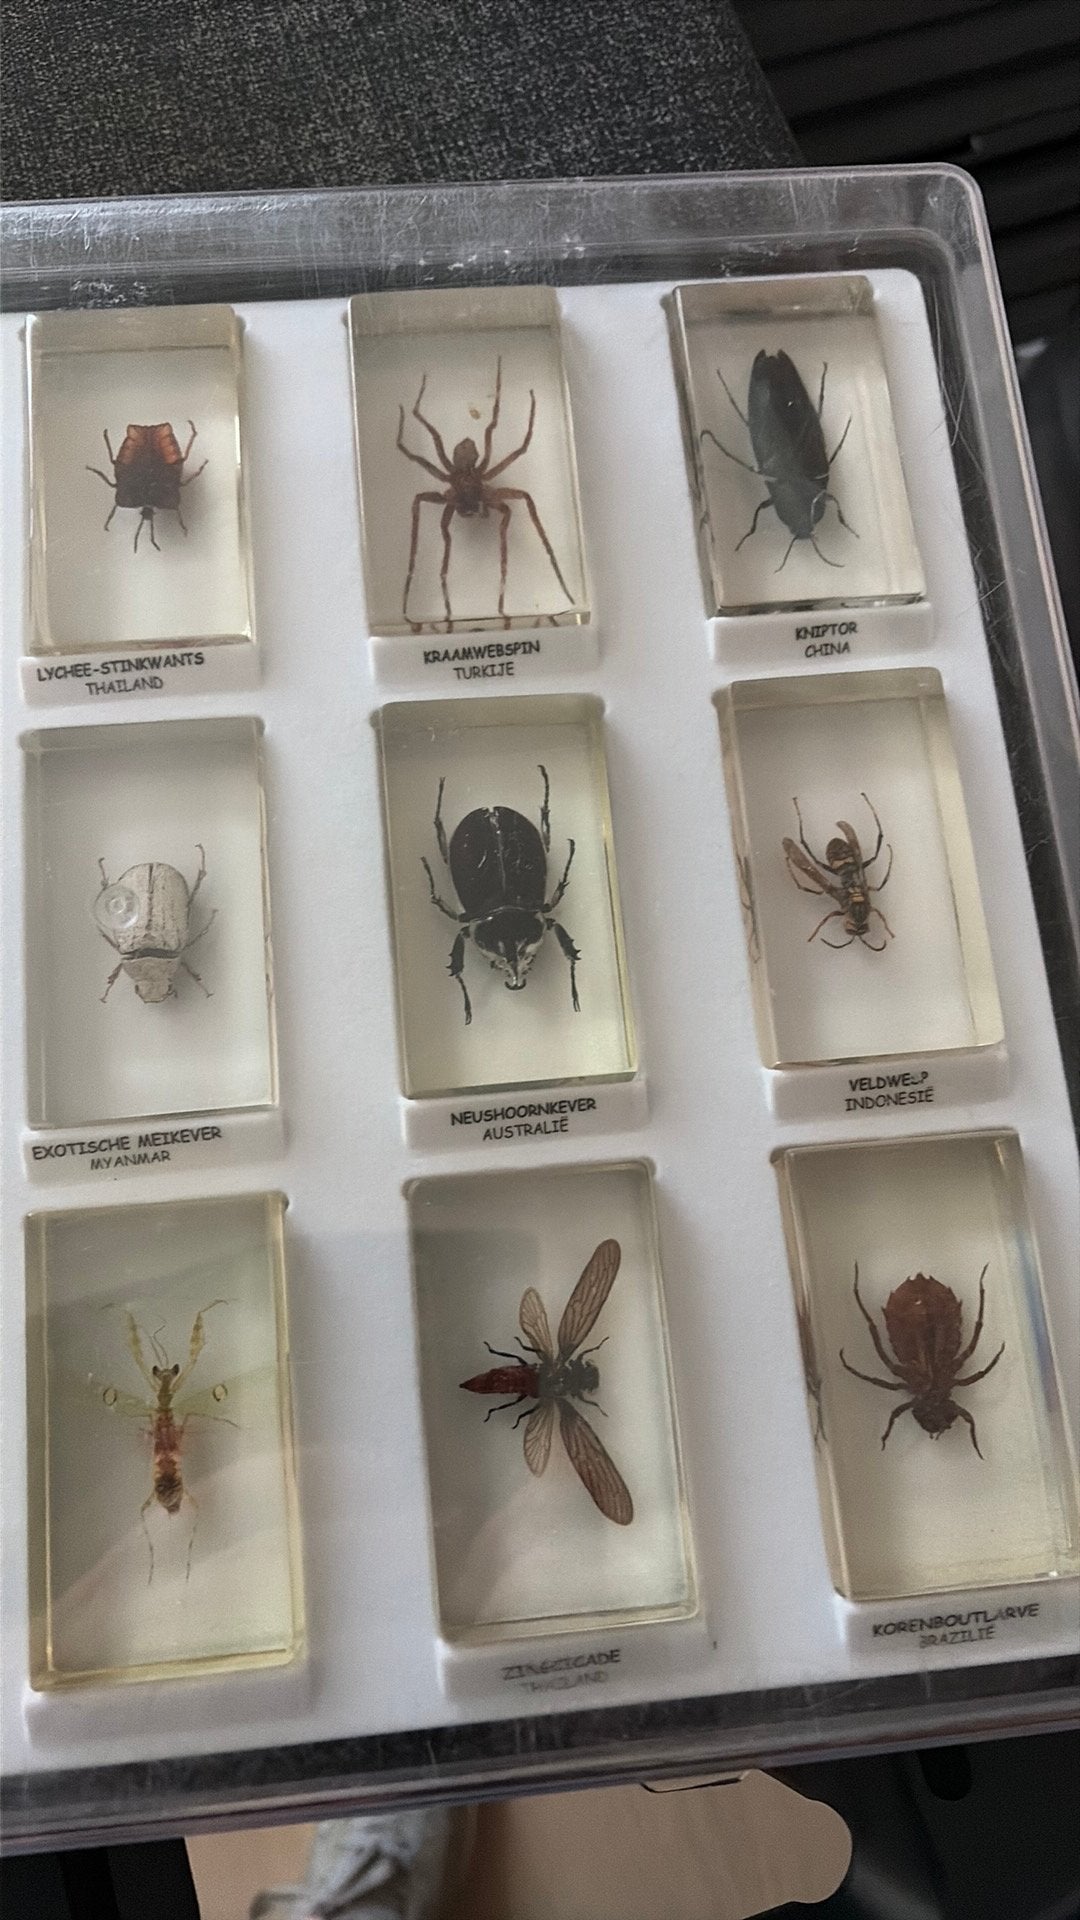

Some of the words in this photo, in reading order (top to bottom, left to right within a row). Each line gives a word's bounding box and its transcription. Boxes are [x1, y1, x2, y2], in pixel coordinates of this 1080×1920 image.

[795, 621, 858, 641] KNIPTOR
[423, 640, 541, 664] KRAAMWEBSPIN
[804, 641, 851, 658] CHINA
[36, 652, 205, 682] LYCHEE-STINKWANTS
[453, 661, 515, 680] TURKIJE
[85, 676, 164, 695] THAILAND
[845, 1086, 935, 1112] INDONESIË
[450, 1098, 597, 1126] NEUSHOORNKEVER
[482, 1116, 569, 1141] AUSTRALIË
[31, 1136, 130, 1161] EXOTISCHE
[137, 1126, 222, 1148] MEIKEVER
[90, 1150, 171, 1170] MYANMAR
[872, 1603, 1040, 1637] KORENBOUTLARVE
